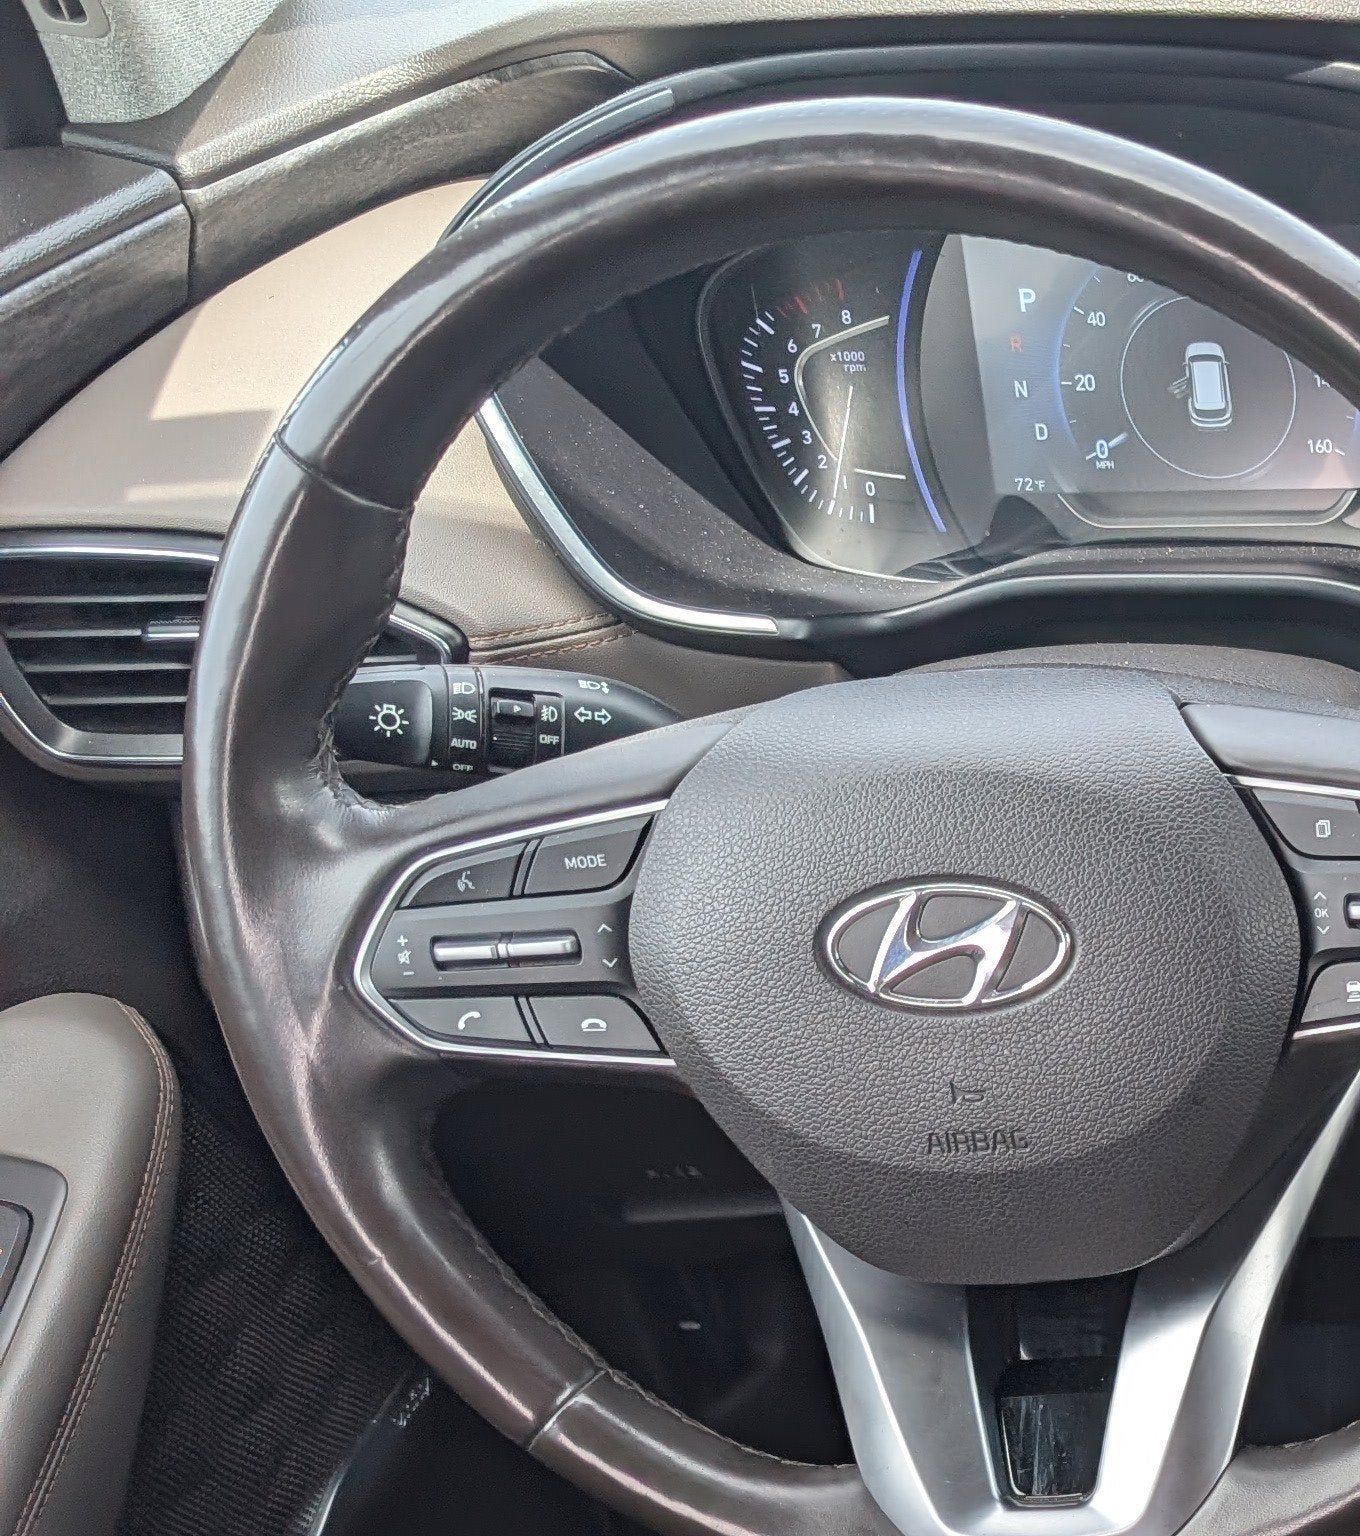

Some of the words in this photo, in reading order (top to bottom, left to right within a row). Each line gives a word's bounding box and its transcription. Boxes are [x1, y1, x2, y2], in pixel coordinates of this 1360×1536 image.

[1018, 288, 1036, 313] P
[841, 309, 852, 325] 8
[1087, 312, 1106, 327] 40
[811, 323, 822, 339] 7
[787, 338, 798, 353] 6
[830, 351, 865, 362] x1000
[843, 363, 867, 373] rpm
[778, 368, 789, 384] 5
[1074, 374, 1096, 392] 20
[1014, 380, 1028, 398] N
[788, 401, 799, 417] 4
[802, 430, 812, 445] 3
[1035, 423, 1048, 441] D
[1095, 439, 1109, 459] 0
[1307, 439, 1333, 453] 160
[818, 454, 828, 469] 2
[1096, 460, 1114, 470] MPH
[865, 481, 876, 497] 0
[451, 738, 477, 749] AUTO
[539, 734, 559, 745] OFF
[452, 763, 473, 772] OFF
[564, 854, 607, 869] MODE
[1314, 908, 1329, 918] OK
[927, 1129, 1029, 1155] AIRBAG
